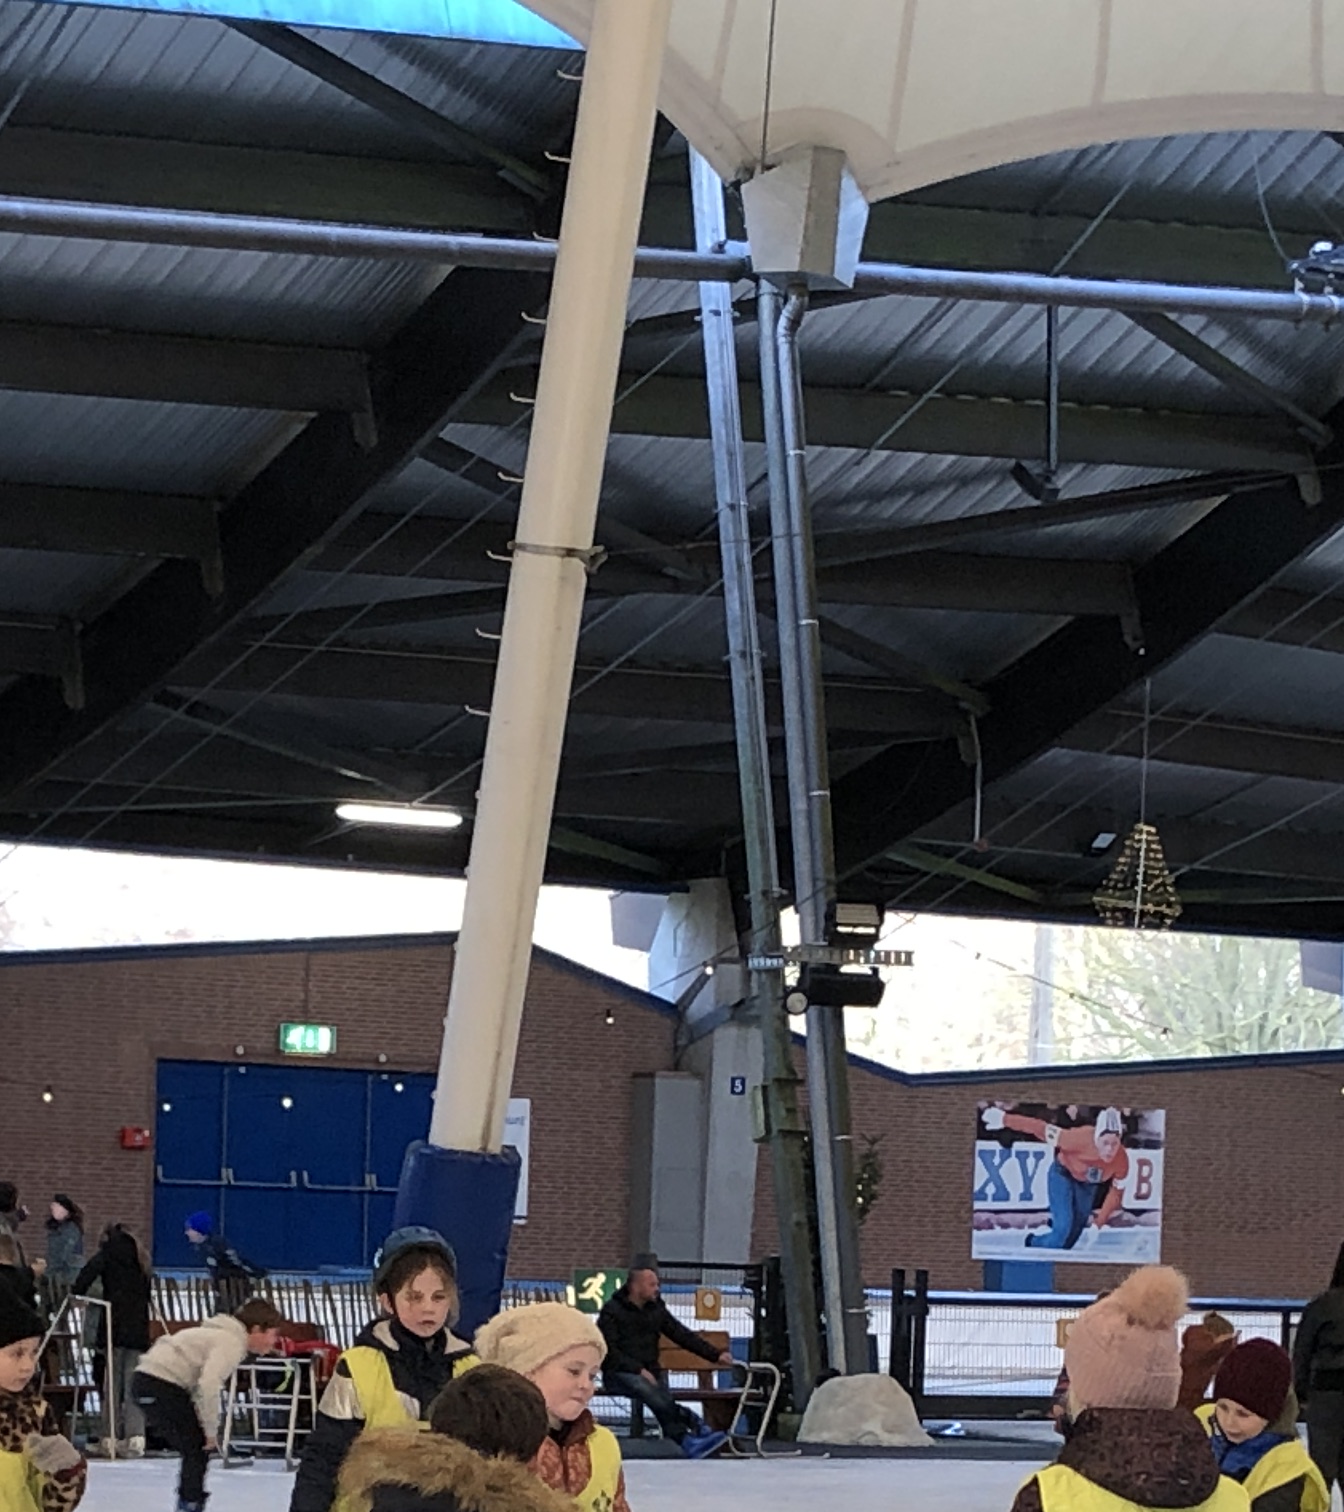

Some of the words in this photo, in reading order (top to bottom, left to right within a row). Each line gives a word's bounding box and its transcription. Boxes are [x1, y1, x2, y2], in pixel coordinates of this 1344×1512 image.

[735, 1079, 742, 1092] 5
[974, 1150, 1046, 1201] XY
[1136, 1159, 1153, 1200] B
